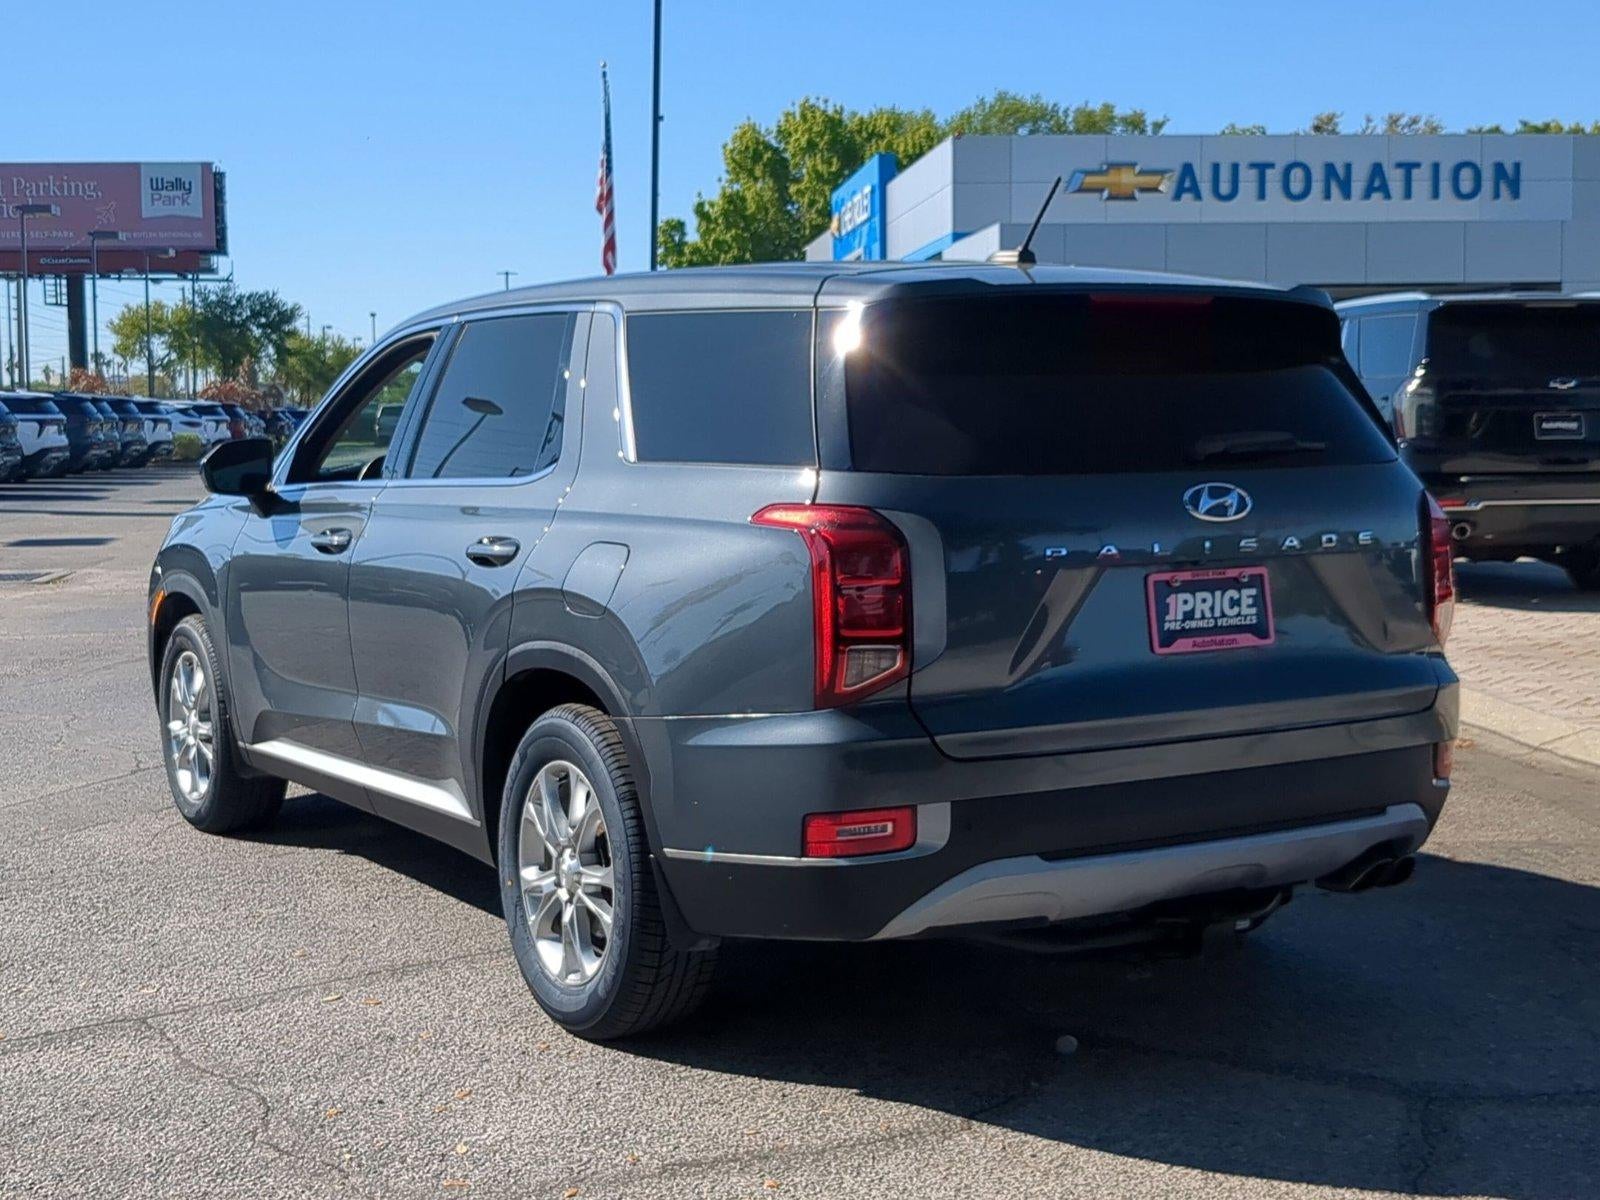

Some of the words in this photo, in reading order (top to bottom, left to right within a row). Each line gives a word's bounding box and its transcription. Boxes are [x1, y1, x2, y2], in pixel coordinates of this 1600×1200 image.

[12, 175, 102, 200] Parking,
[150, 176, 192, 195] Wally
[1173, 161, 1522, 202] AUTONATION
[151, 192, 191, 207] Park
[1045, 531, 1374, 560] PALISADE
[1164, 618, 1216, 631] PRE-OWNED
[1217, 615, 1258, 627] VEHICLES
